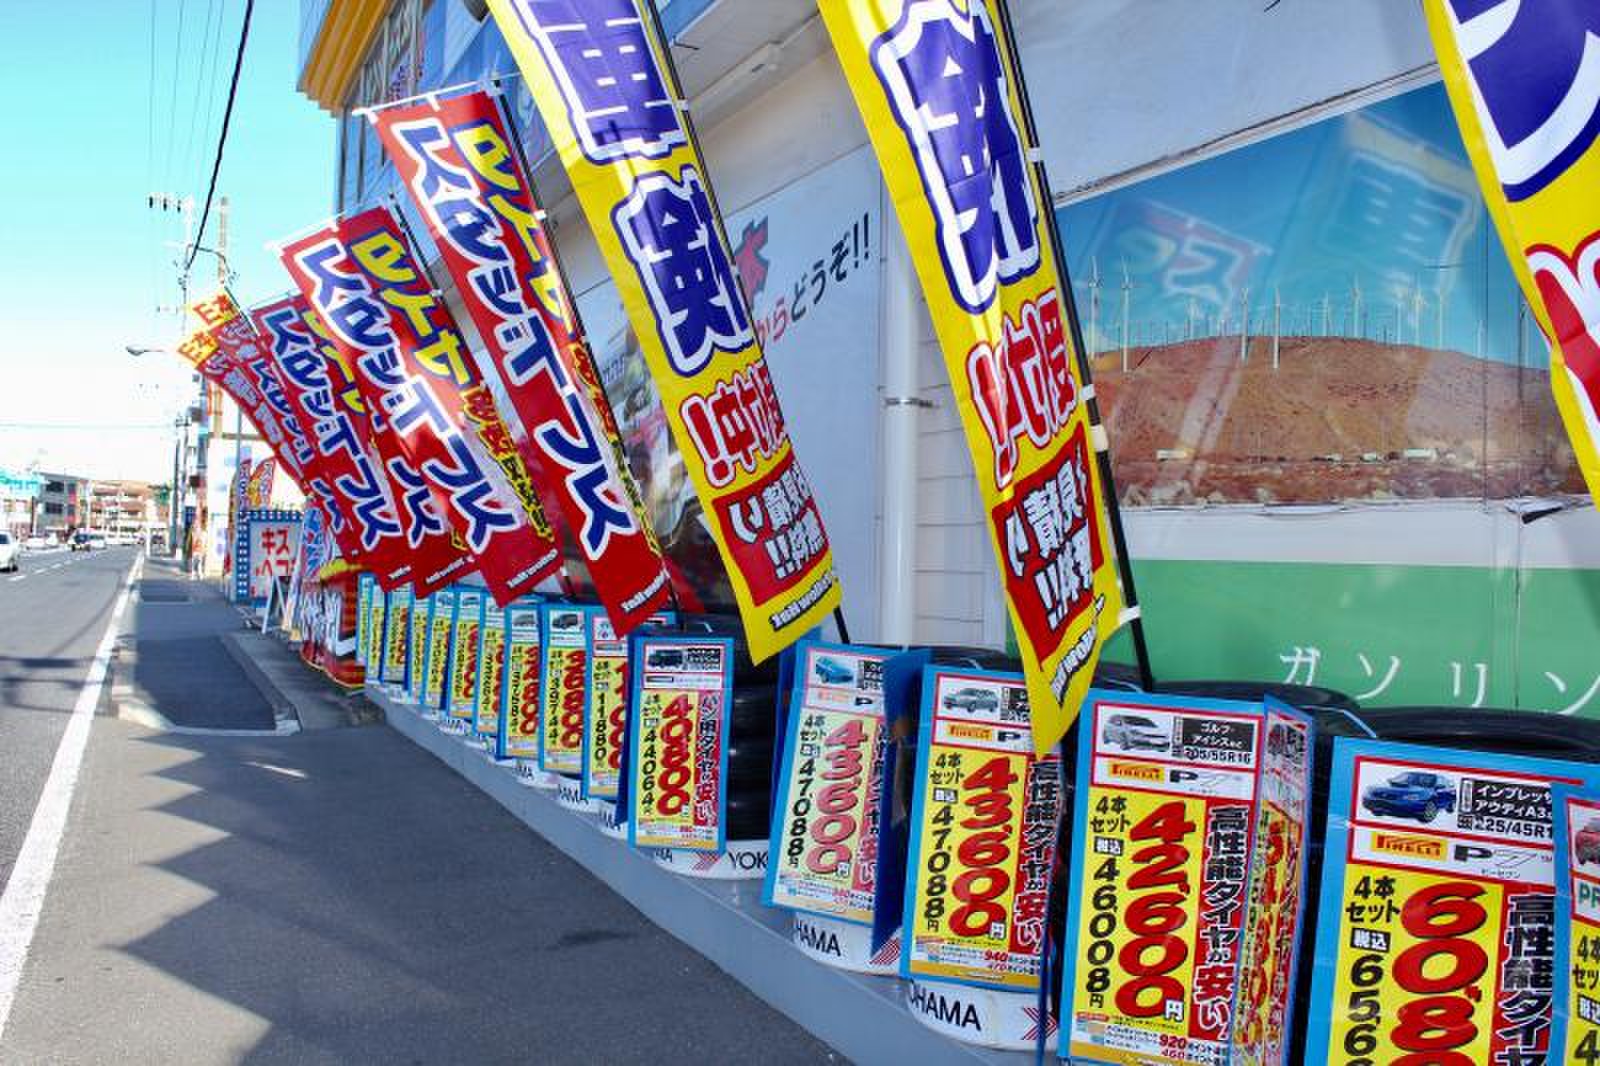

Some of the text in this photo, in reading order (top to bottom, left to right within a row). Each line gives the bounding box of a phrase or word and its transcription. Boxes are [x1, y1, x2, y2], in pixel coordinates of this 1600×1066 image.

[1279, 646, 1600, 716] ガソリン
[1095, 795, 1128, 815] 4本
[1089, 814, 1131, 833] セット
[1375, 834, 1443, 859] PIRELLI
[727, 851, 769, 870] YOK
[1353, 875, 1396, 900] 4本
[1345, 899, 1401, 924] セット
[1352, 930, 1389, 951] 税込
